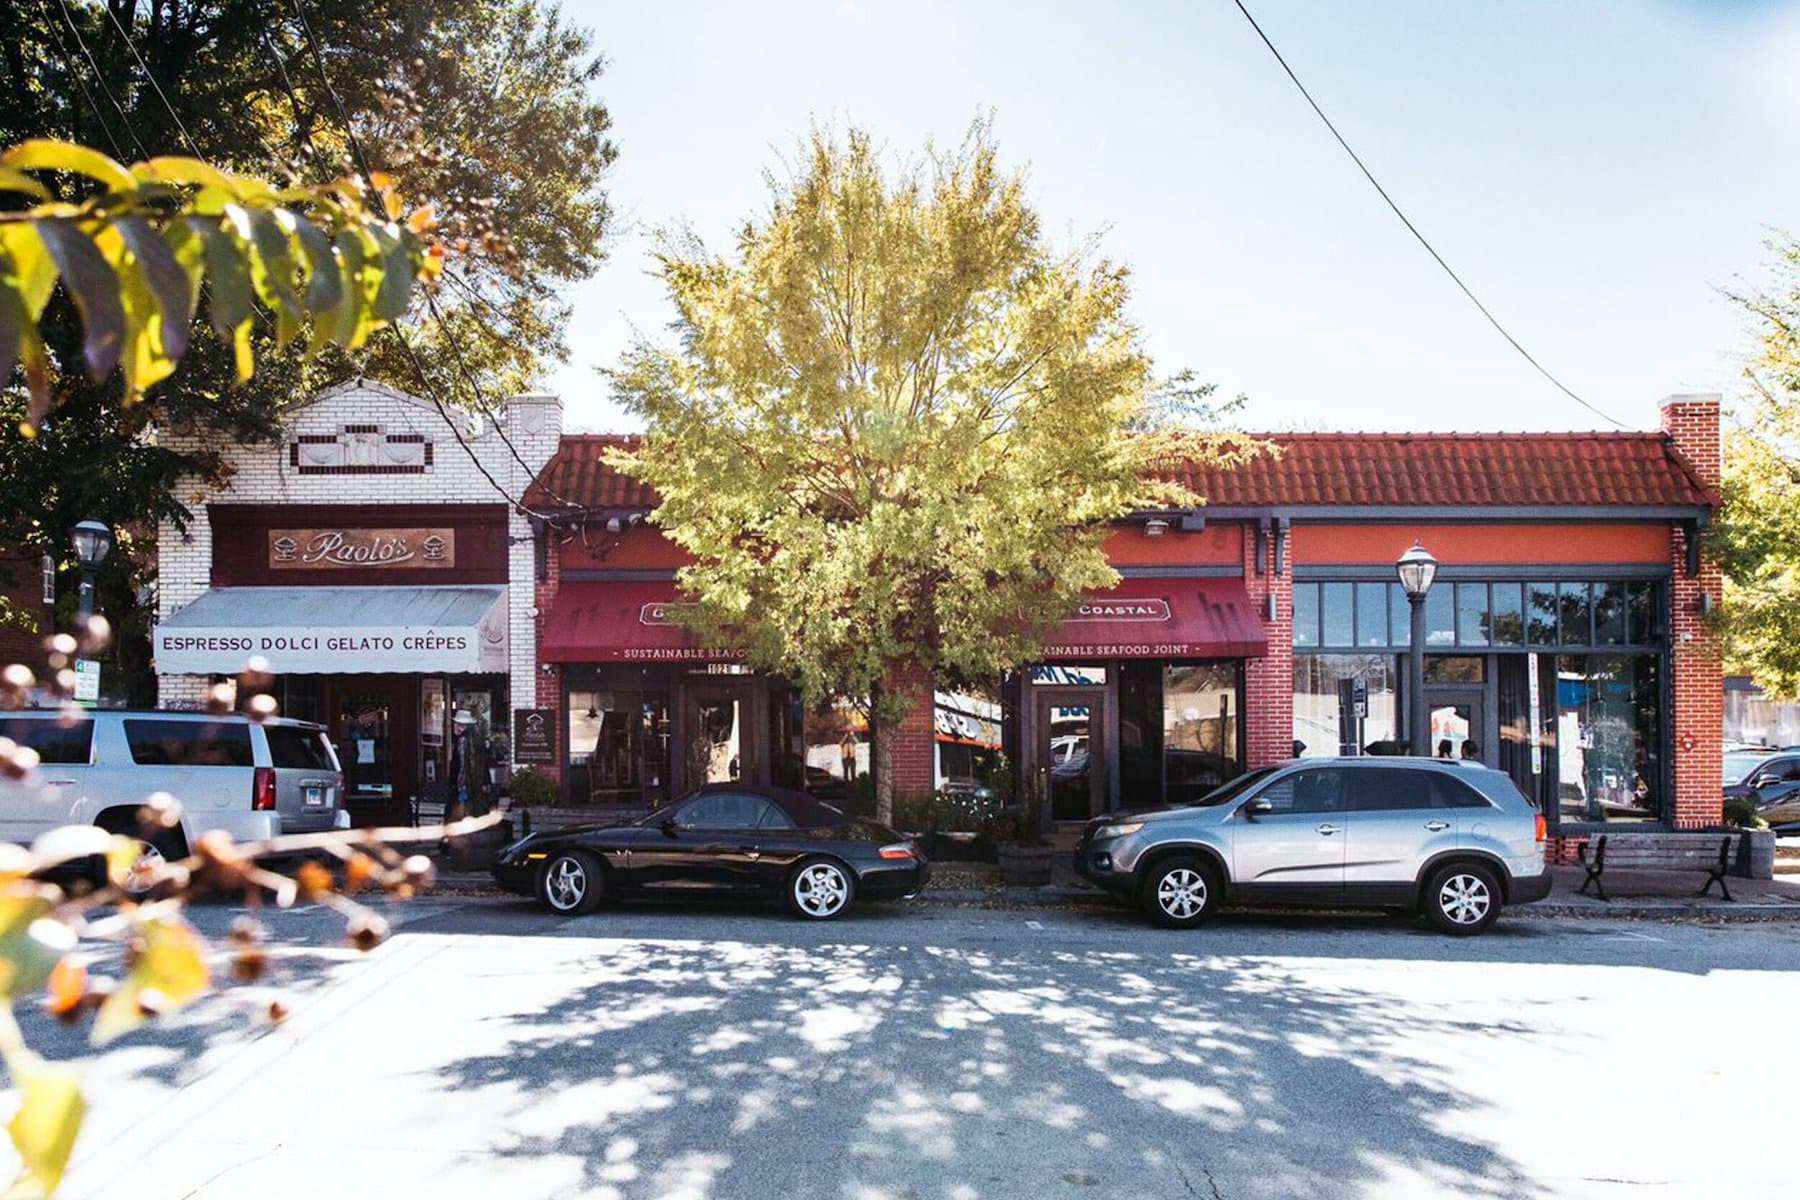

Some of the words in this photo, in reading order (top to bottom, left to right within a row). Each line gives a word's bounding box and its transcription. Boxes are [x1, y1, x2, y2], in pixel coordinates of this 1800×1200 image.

[302, 531, 415, 565] Paolo's
[1079, 605, 1158, 615] COASTAL
[162, 637, 253, 651] ESPRESSO
[260, 637, 319, 650] DOLCI
[326, 637, 394, 650] GELATO
[402, 630, 467, 650] CRÊPES
[623, 648, 704, 658] SUSTAINABLE
[1096, 645, 1150, 656] SEAFOOD
[1152, 644, 1189, 654] JOINT
